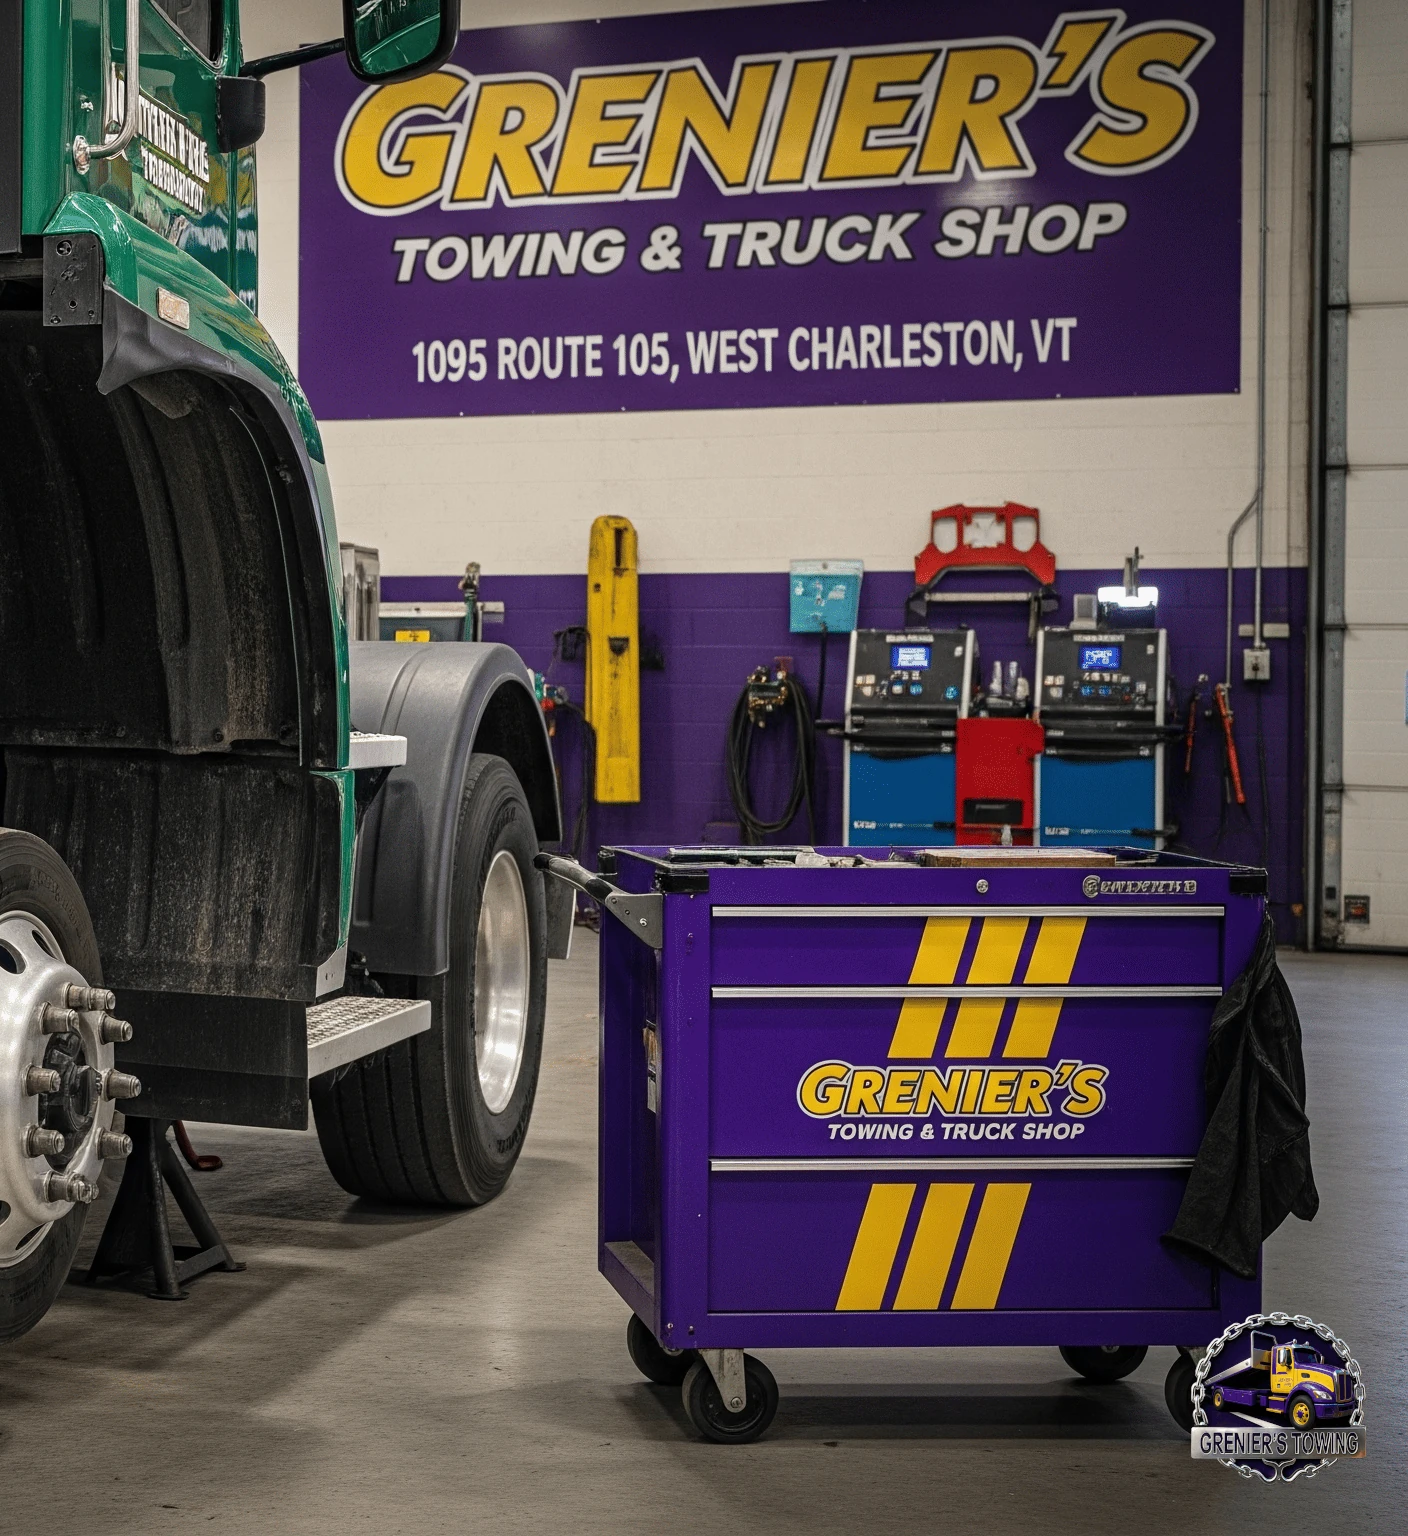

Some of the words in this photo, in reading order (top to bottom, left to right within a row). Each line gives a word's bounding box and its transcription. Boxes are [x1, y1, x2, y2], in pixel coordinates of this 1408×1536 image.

[336, 10, 1214, 216] GRENIER'S
[393, 227, 627, 283] TOWING
[640, 225, 683, 273] &
[703, 211, 922, 269] TRUCK
[933, 202, 1128, 258] SHOP
[411, 338, 488, 383] 1095
[497, 335, 604, 380] ROUTE
[612, 331, 680, 384] 105,
[686, 328, 779, 374] WEST
[787, 318, 1023, 373] CHARLESTON,
[1030, 316, 1078, 363] VT
[796, 1059, 1109, 1119] GRENIER'S
[828, 1123, 914, 1140] TOWING
[920, 1123, 935, 1140] &
[941, 1122, 1016, 1140] TRUCK
[1022, 1123, 1085, 1140] SHOP
